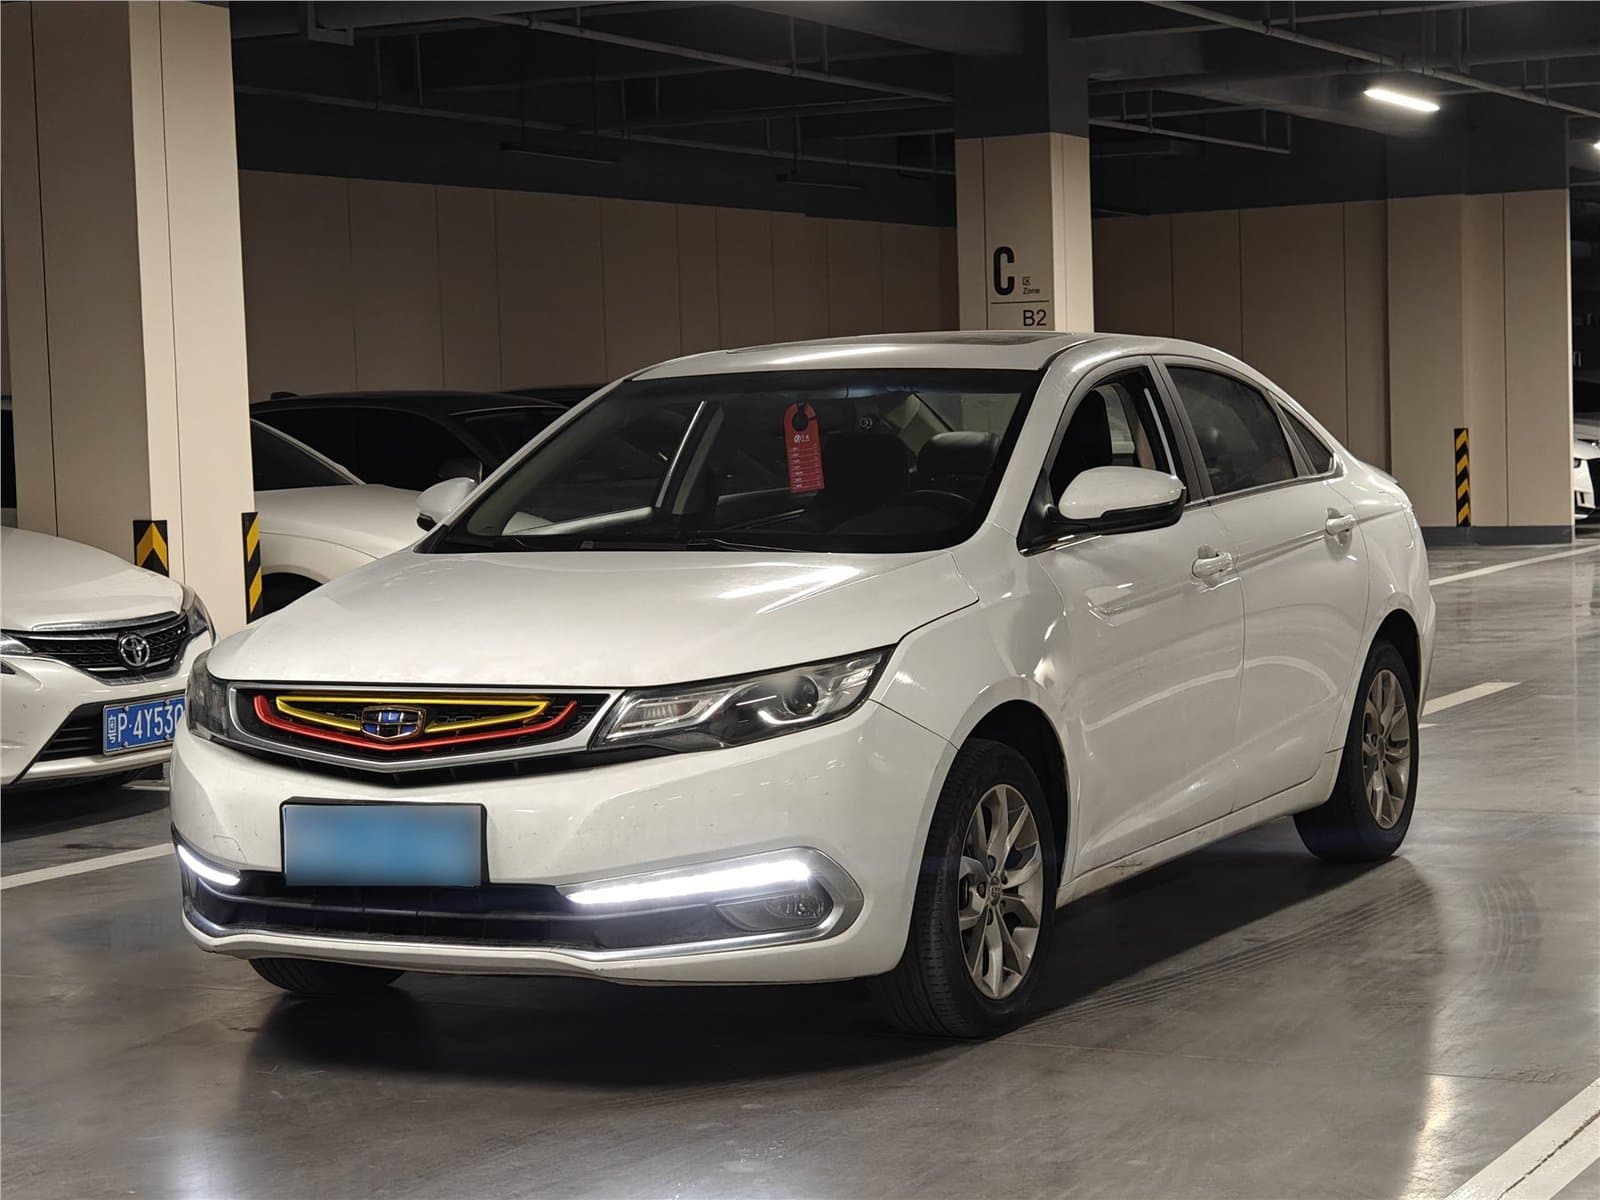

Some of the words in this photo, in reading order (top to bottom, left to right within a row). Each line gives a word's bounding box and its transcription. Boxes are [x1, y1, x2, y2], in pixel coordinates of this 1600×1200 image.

[993, 246, 1015, 296] C
[1023, 287, 1041, 295] Zone
[1023, 309, 1047, 327] B2
